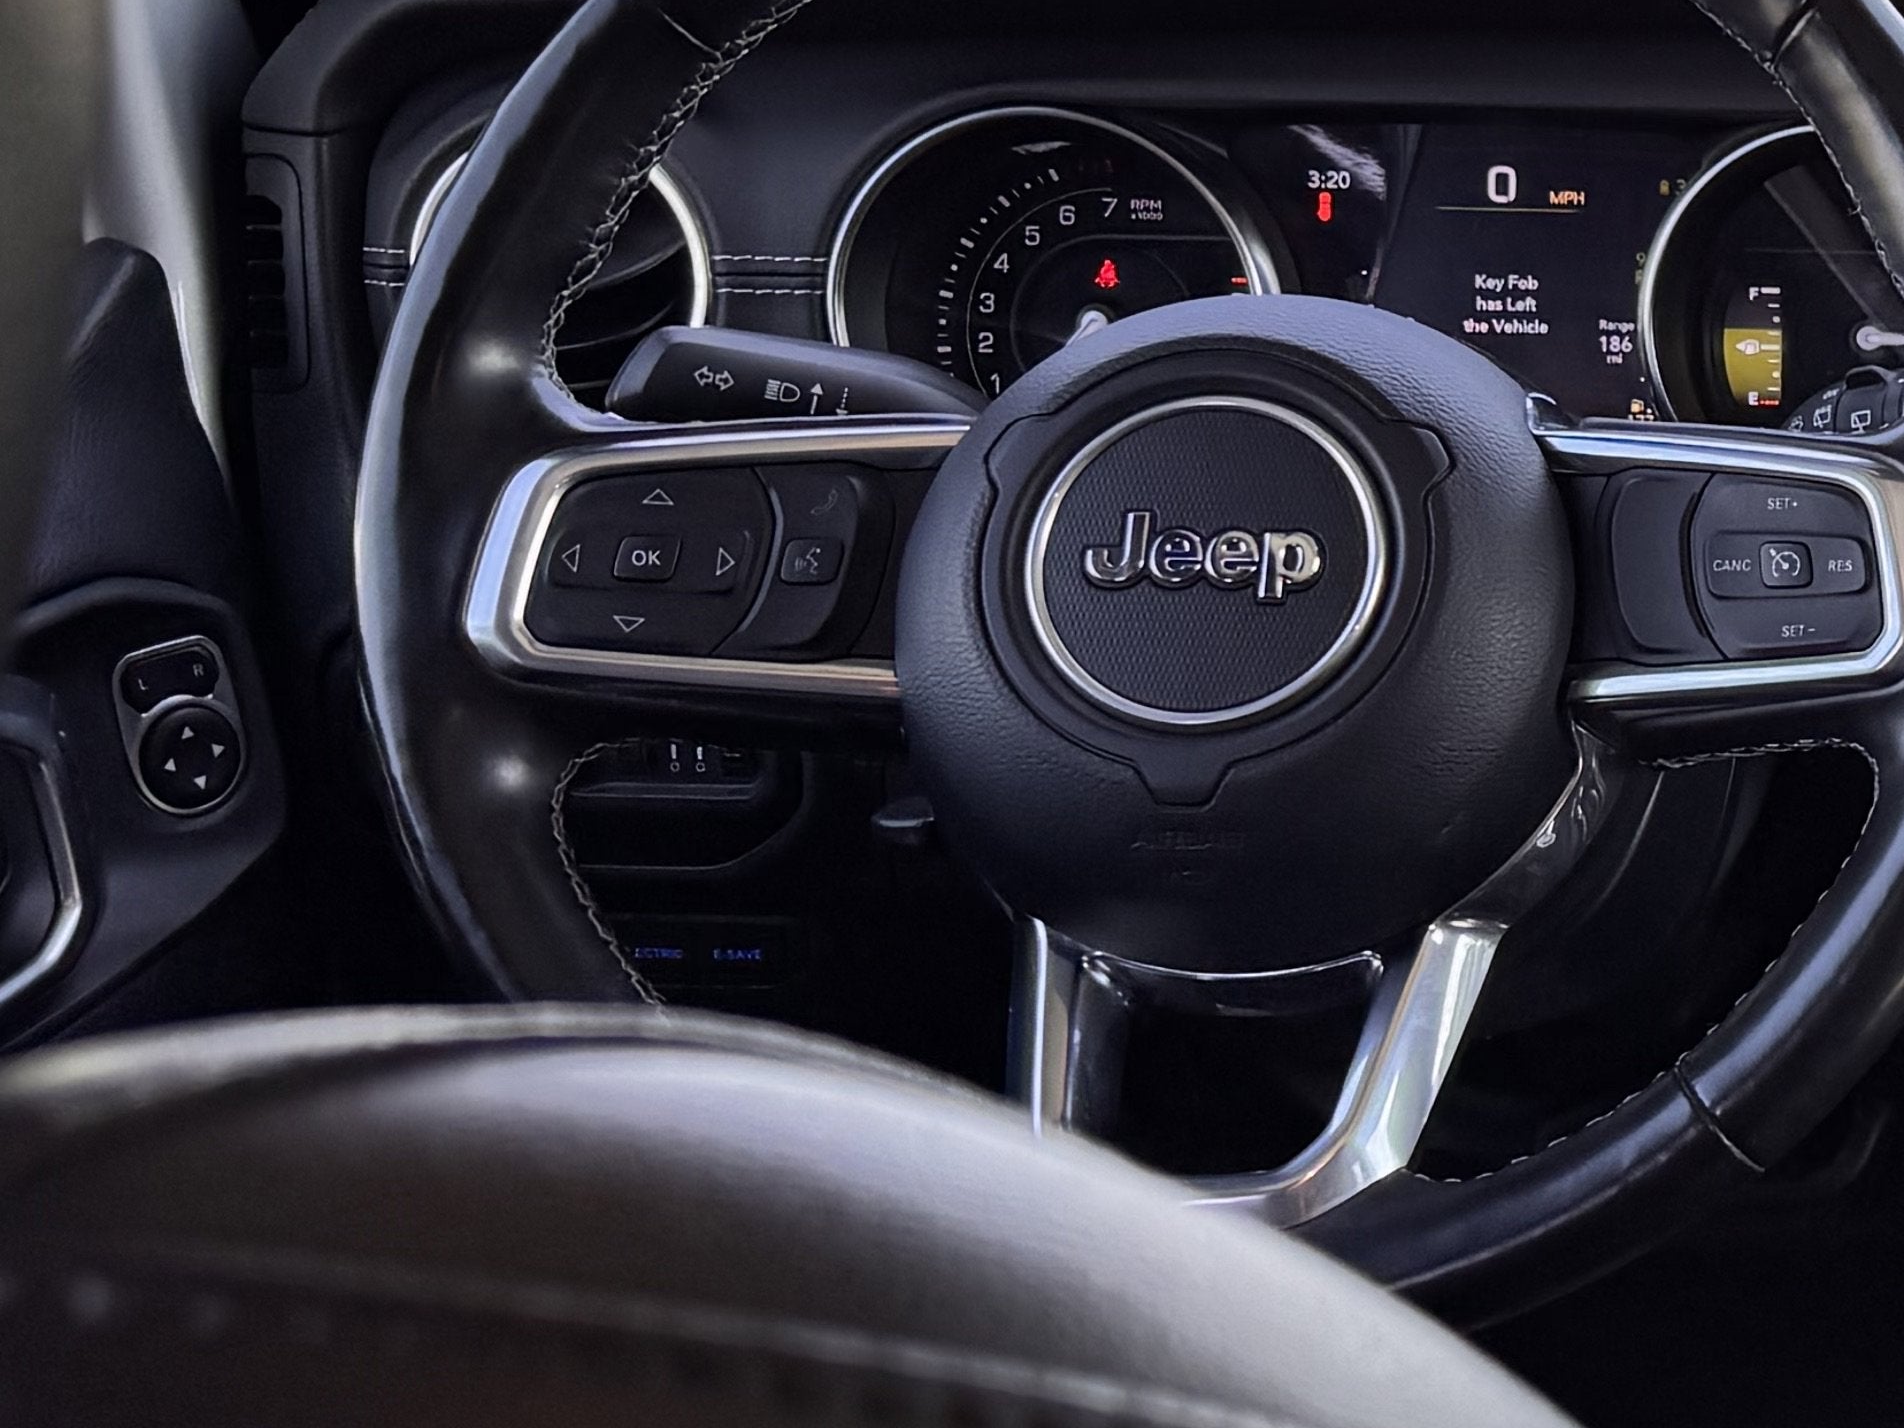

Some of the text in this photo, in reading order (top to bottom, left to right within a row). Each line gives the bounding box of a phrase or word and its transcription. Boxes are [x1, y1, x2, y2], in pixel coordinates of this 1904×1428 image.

[1307, 170, 1351, 189] 3:20
[1487, 165, 1518, 204] 0
[1129, 199, 1162, 211] RPM
[1549, 190, 1585, 206] MPH
[1059, 205, 1075, 225] 6
[1101, 197, 1118, 217] 7
[1025, 225, 1040, 246] 5
[993, 253, 1010, 274] 4
[1474, 274, 1539, 291] Key Fob
[979, 292, 995, 313] 3
[1749, 287, 1760, 301] F
[1476, 296, 1537, 313] has Left
[1462, 318, 1549, 335] the Vehicle
[1599, 319, 1635, 333] Range
[978, 332, 994, 353] 2
[1599, 336, 1633, 354] 186
[990, 373, 1000, 394] 1
[1748, 392, 1759, 406] E
[632, 549, 662, 567] OK
[1085, 510, 1324, 602] Jeep
[1713, 559, 1751, 572] CANC
[1827, 559, 1853, 572] RES
[192, 663, 204, 677] R
[138, 678, 149, 691] L
